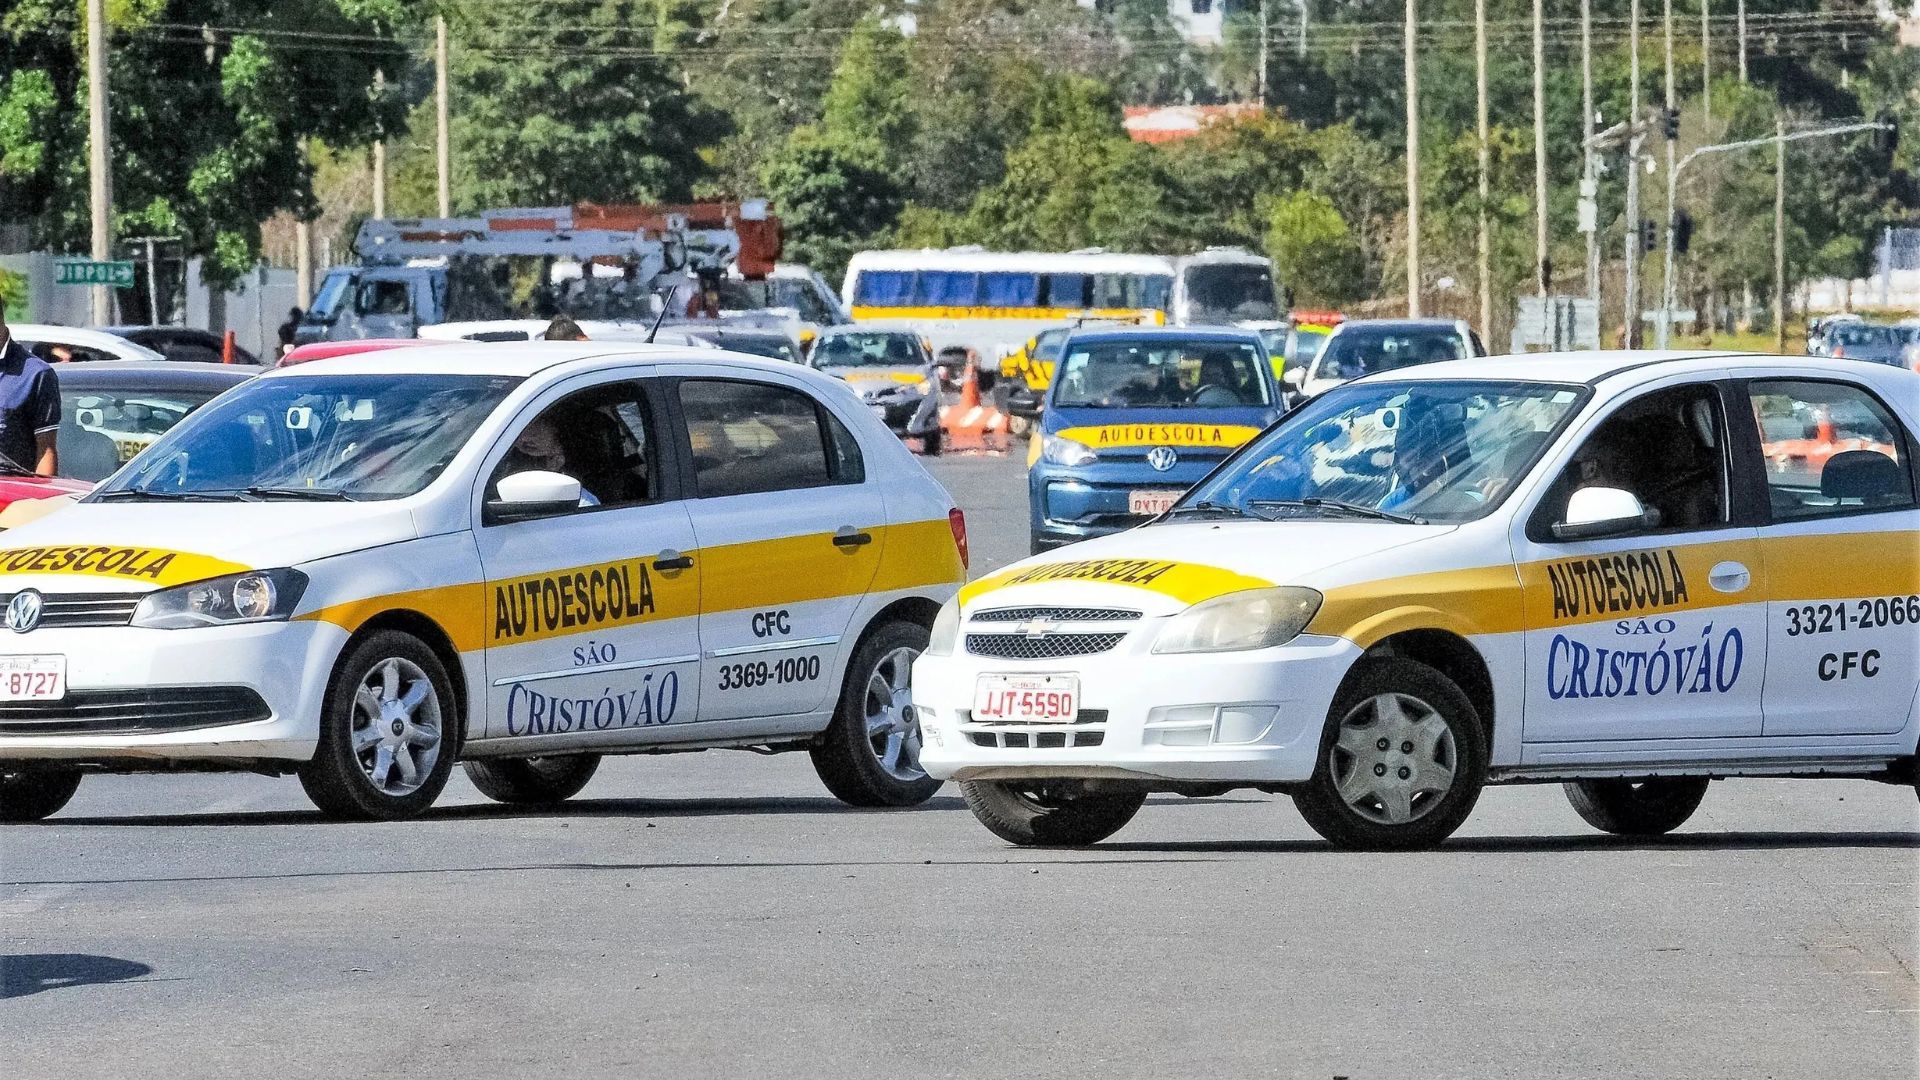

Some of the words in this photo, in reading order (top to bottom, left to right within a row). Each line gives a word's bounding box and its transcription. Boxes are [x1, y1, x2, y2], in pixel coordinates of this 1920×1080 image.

[1100, 426, 1222, 443] AUTOESCOLA
[0, 547, 177, 578] TOESCOLA
[1003, 560, 1177, 585] AUTOESCOLA
[494, 563, 655, 640] AUTOESCOLA
[1547, 550, 1689, 620] AUTOESCOLA
[751, 610, 791, 638] CFC
[1615, 617, 1677, 636] SÃO
[1786, 595, 1920, 637] 3321-2066
[573, 641, 617, 667] SÃO
[1547, 621, 1744, 700] CRISTÓVÃO
[1818, 649, 1881, 682] CFC
[718, 655, 820, 690] 3369-1000
[507, 670, 679, 737] CRISTÓVÃO
